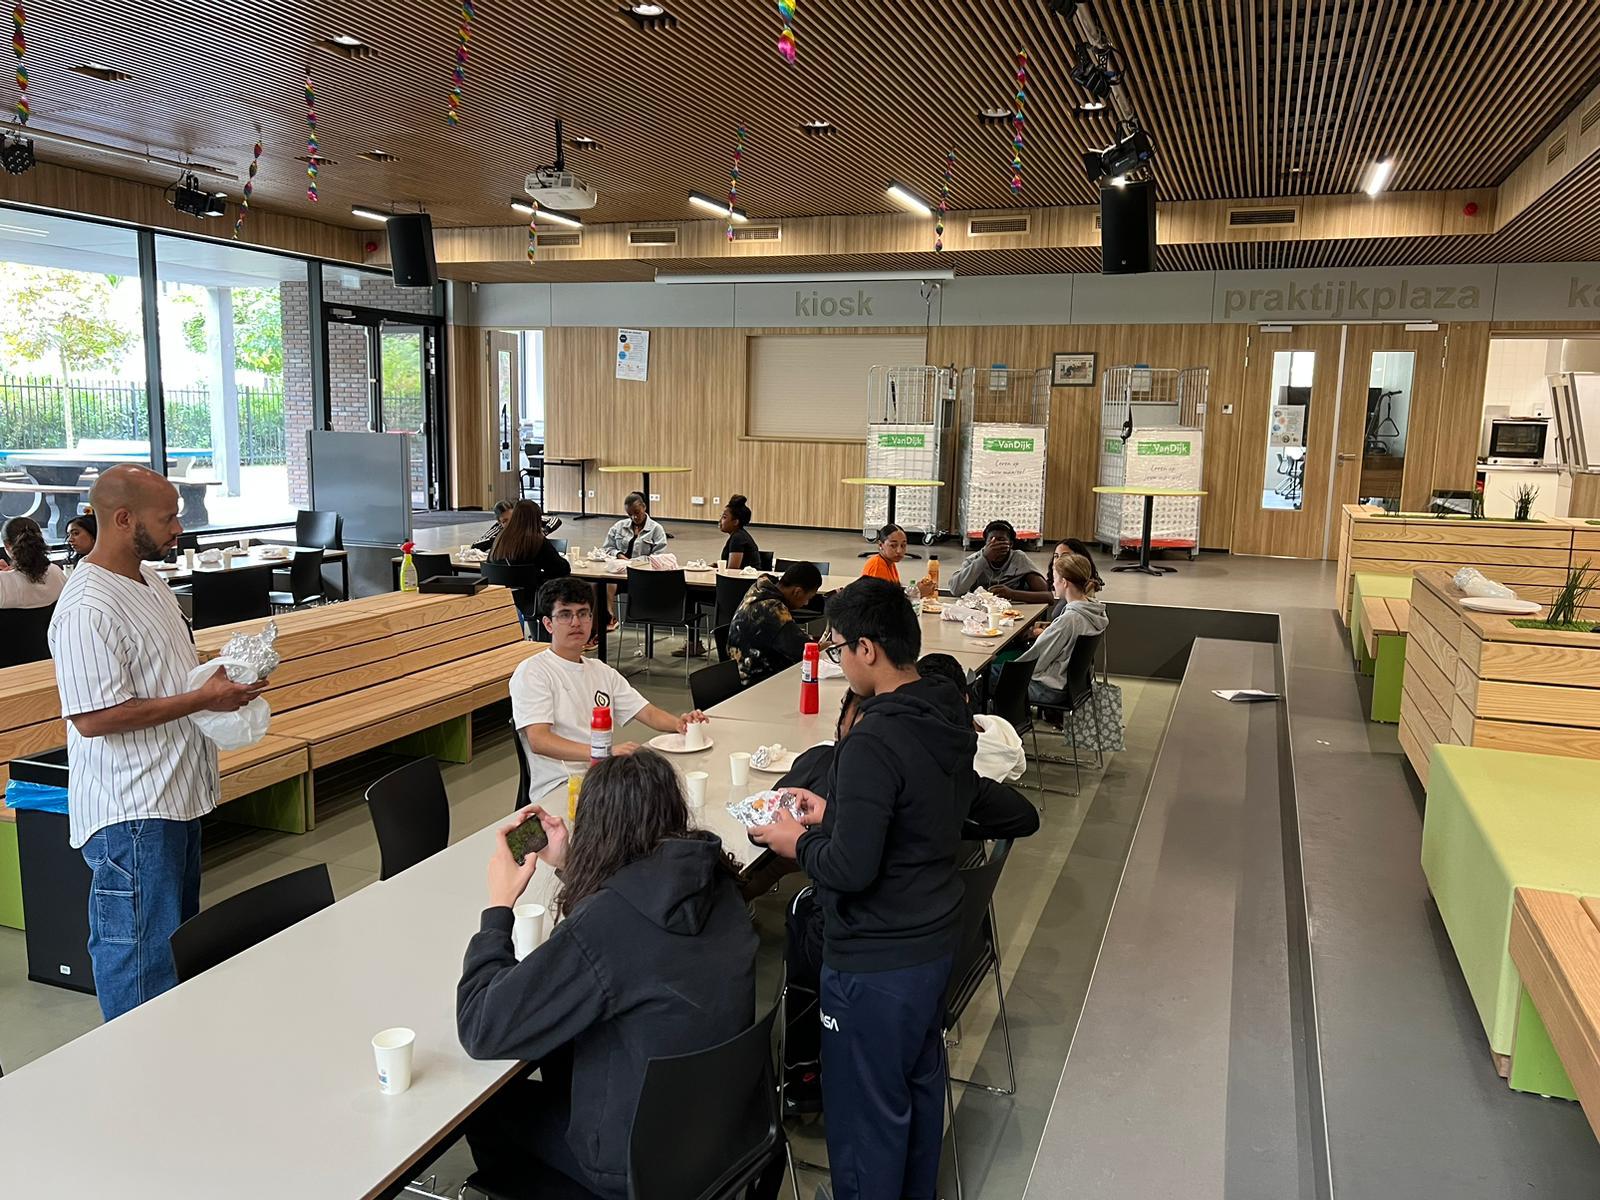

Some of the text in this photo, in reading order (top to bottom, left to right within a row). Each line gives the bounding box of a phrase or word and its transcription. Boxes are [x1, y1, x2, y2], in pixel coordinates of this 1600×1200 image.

[795, 288, 873, 317] kiosk
[1224, 280, 1480, 319] praktijkplaza
[998, 440, 1031, 450] VanDijk
[1153, 443, 1188, 454] VanDijk
